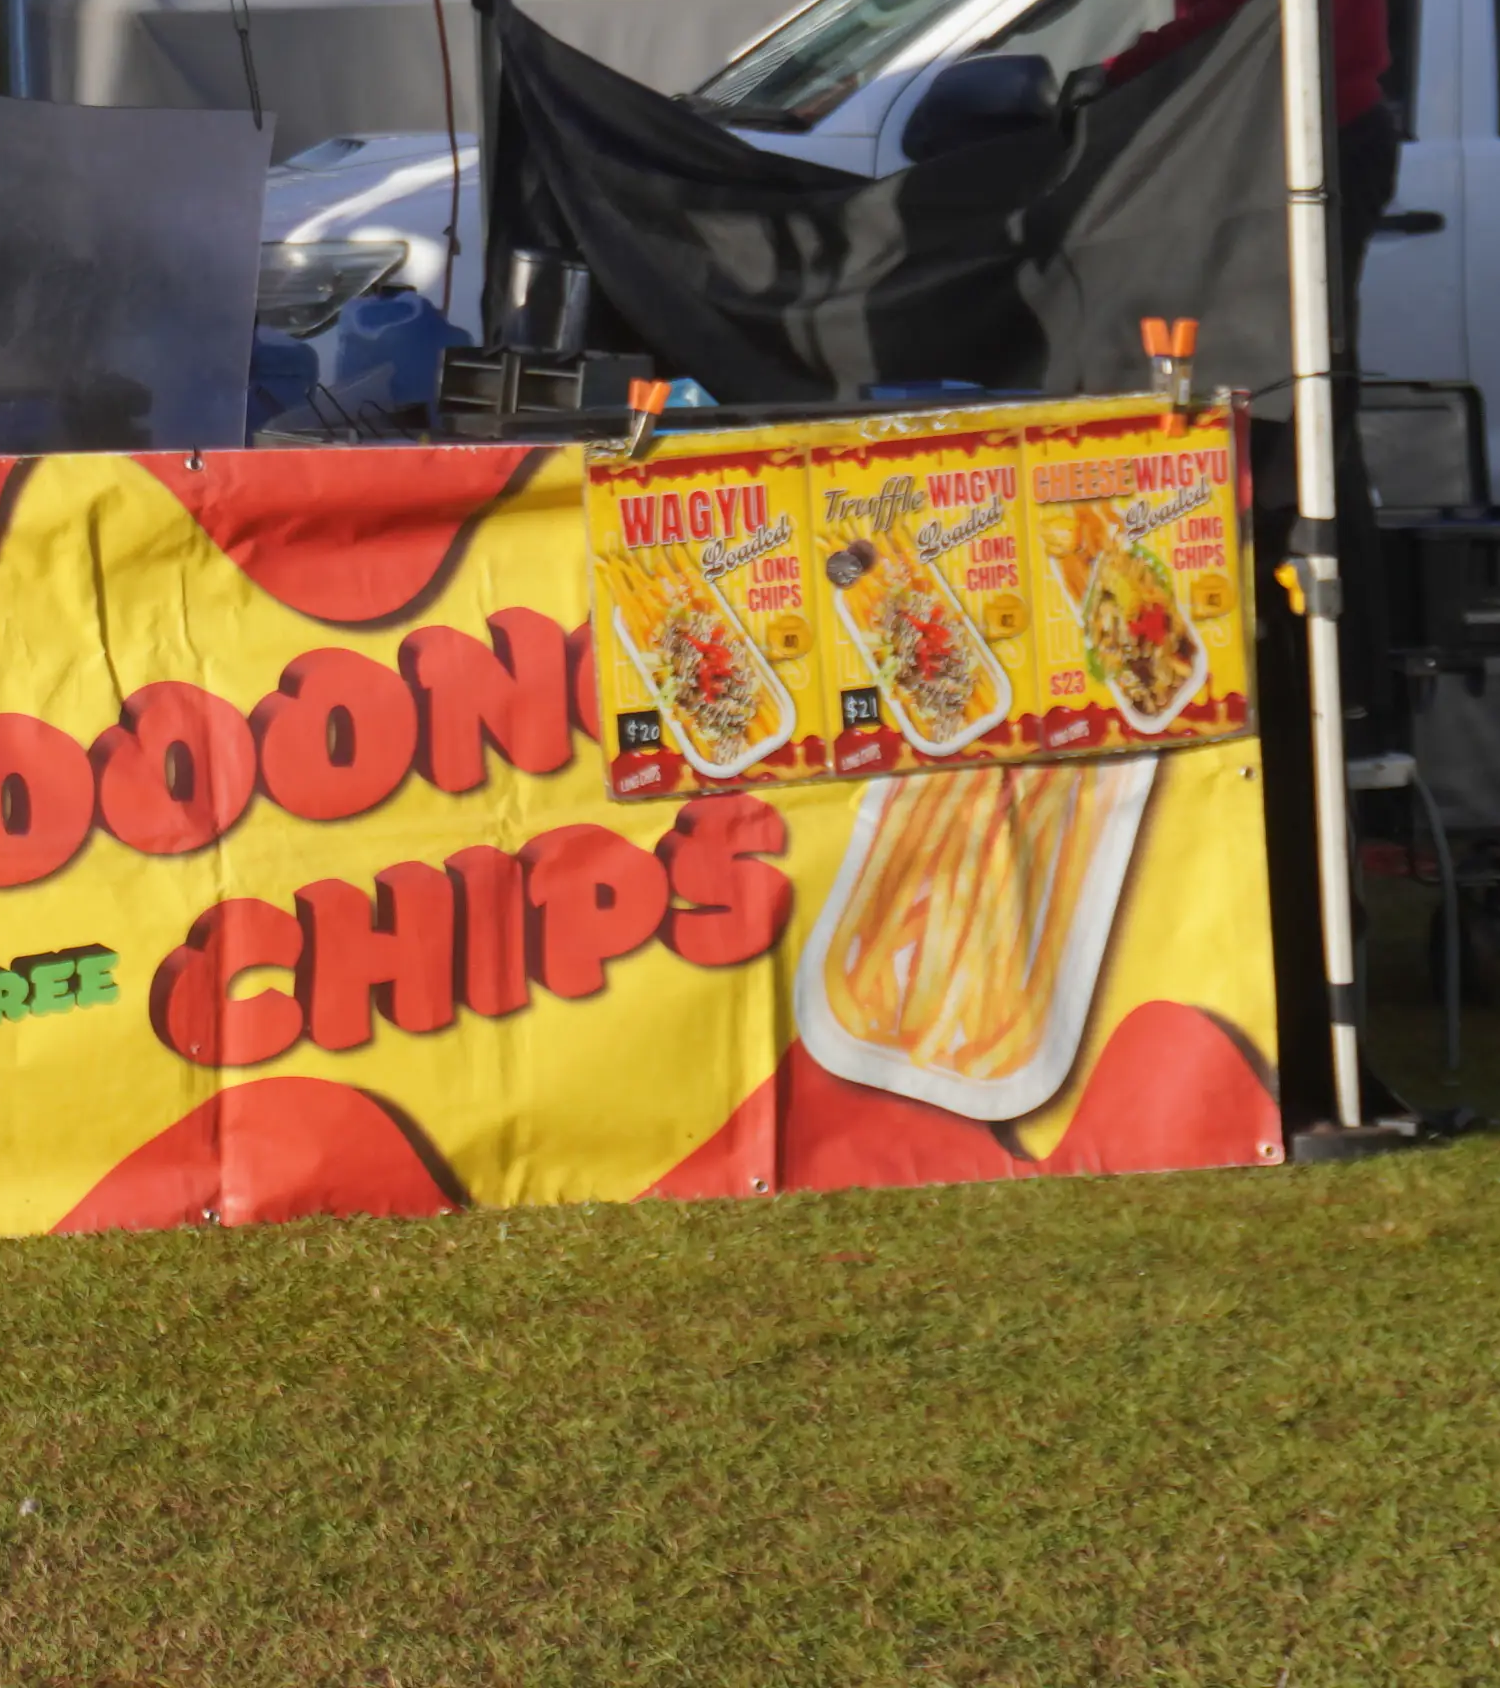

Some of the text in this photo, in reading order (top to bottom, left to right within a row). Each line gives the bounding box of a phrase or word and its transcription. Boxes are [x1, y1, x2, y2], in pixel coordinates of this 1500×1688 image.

[1033, 449, 1229, 504] CHEESE WAGYU
[619, 483, 768, 550] WAGYU
[824, 467, 1017, 532] Truffle WAGYU
[1125, 477, 1211, 542] Loaded
[703, 516, 792, 582] Loaded
[917, 495, 1004, 564] Loaded
[971, 536, 1016, 564] LONG
[1177, 516, 1224, 544] LONG
[751, 555, 799, 584] LONG
[966, 565, 1018, 592] CHIPS
[1173, 544, 1226, 572] CHIPS
[748, 583, 802, 612] CHIPS
[1050, 670, 1086, 696] $23
[149, 790, 796, 1069] CHIPS
